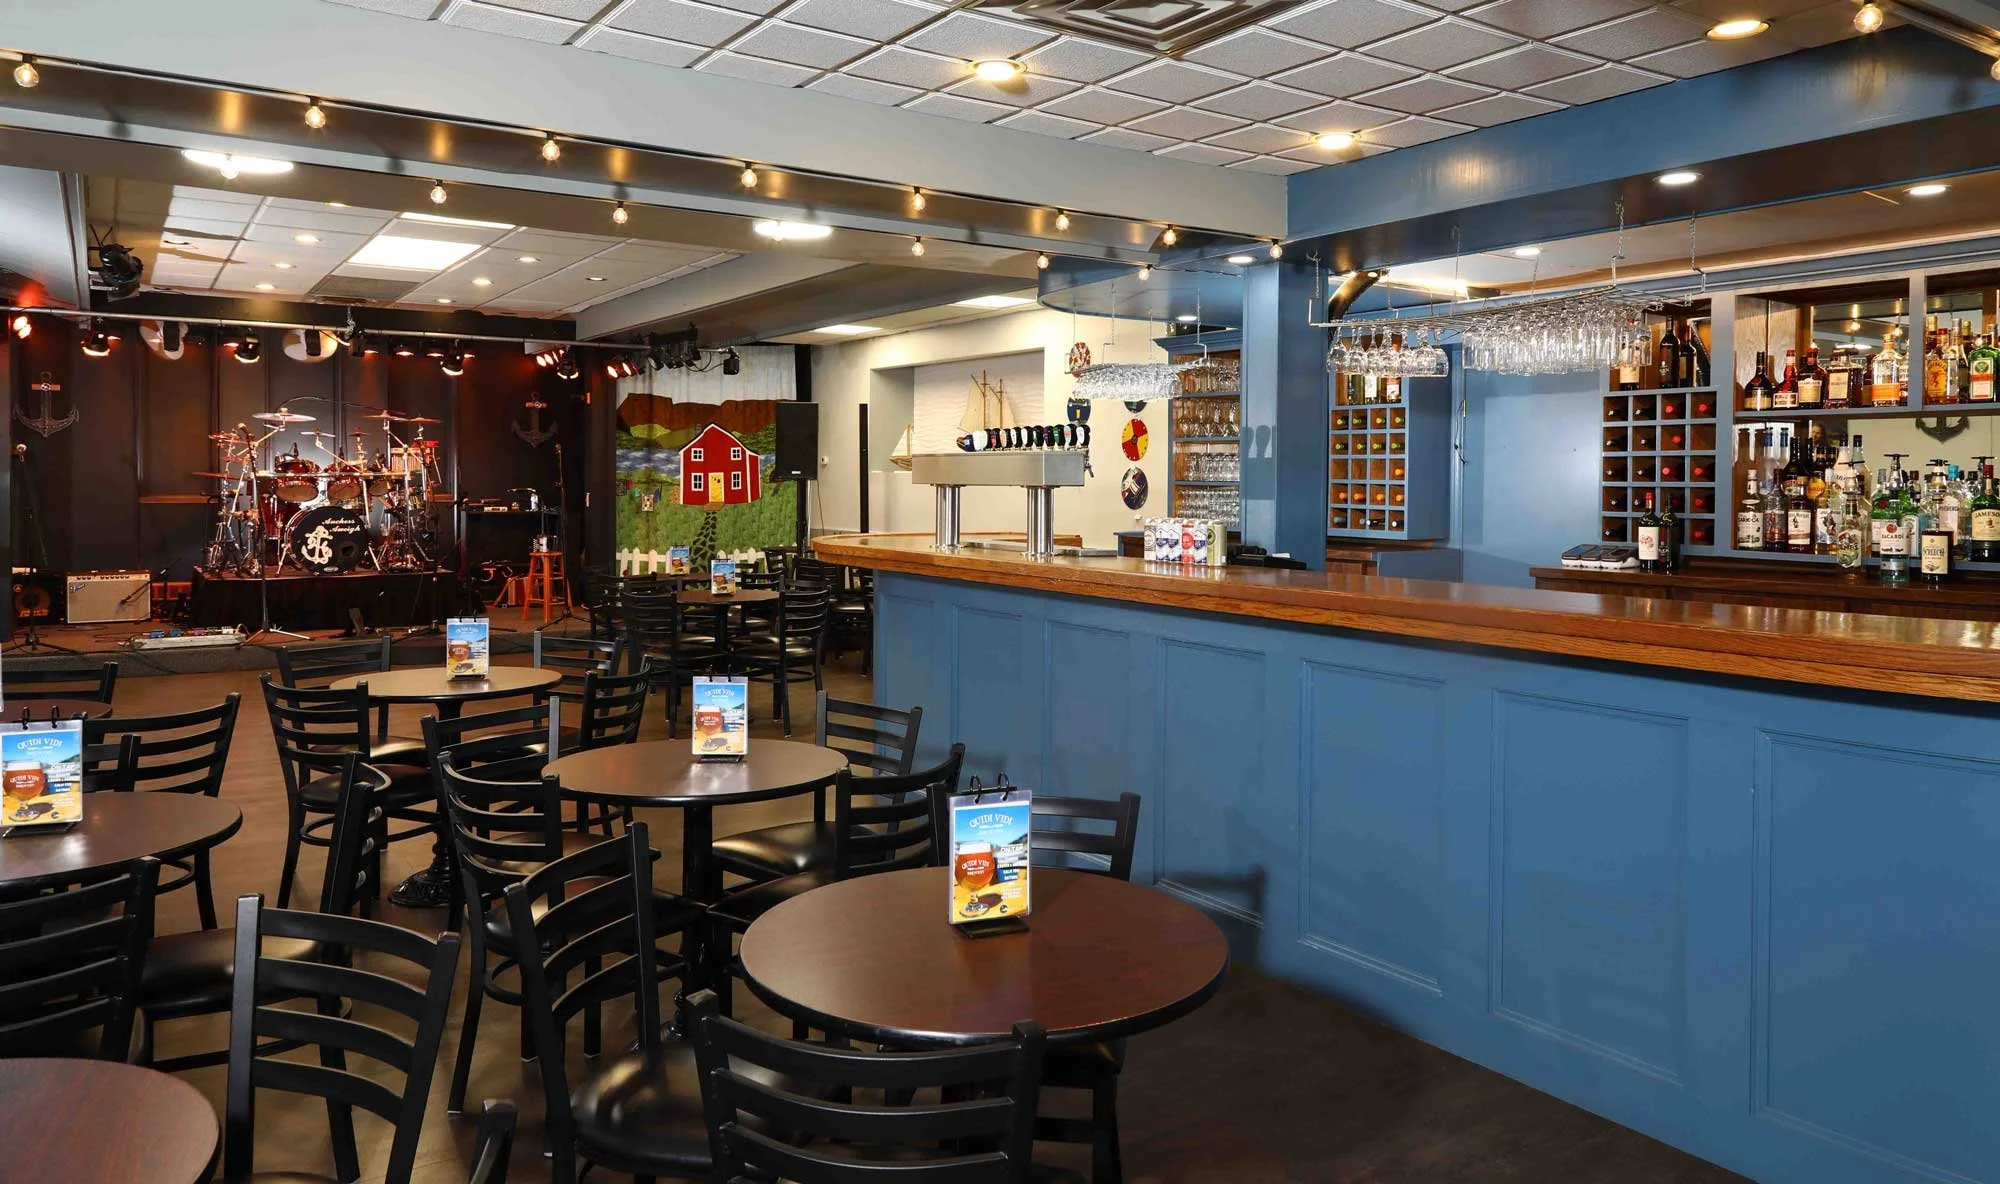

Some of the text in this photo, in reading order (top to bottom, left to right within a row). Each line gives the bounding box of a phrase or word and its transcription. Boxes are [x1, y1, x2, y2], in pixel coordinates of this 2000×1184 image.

[17, 738, 63, 750] QUIDI VIDI
[969, 814, 1013, 827] QUIDI VIDI
